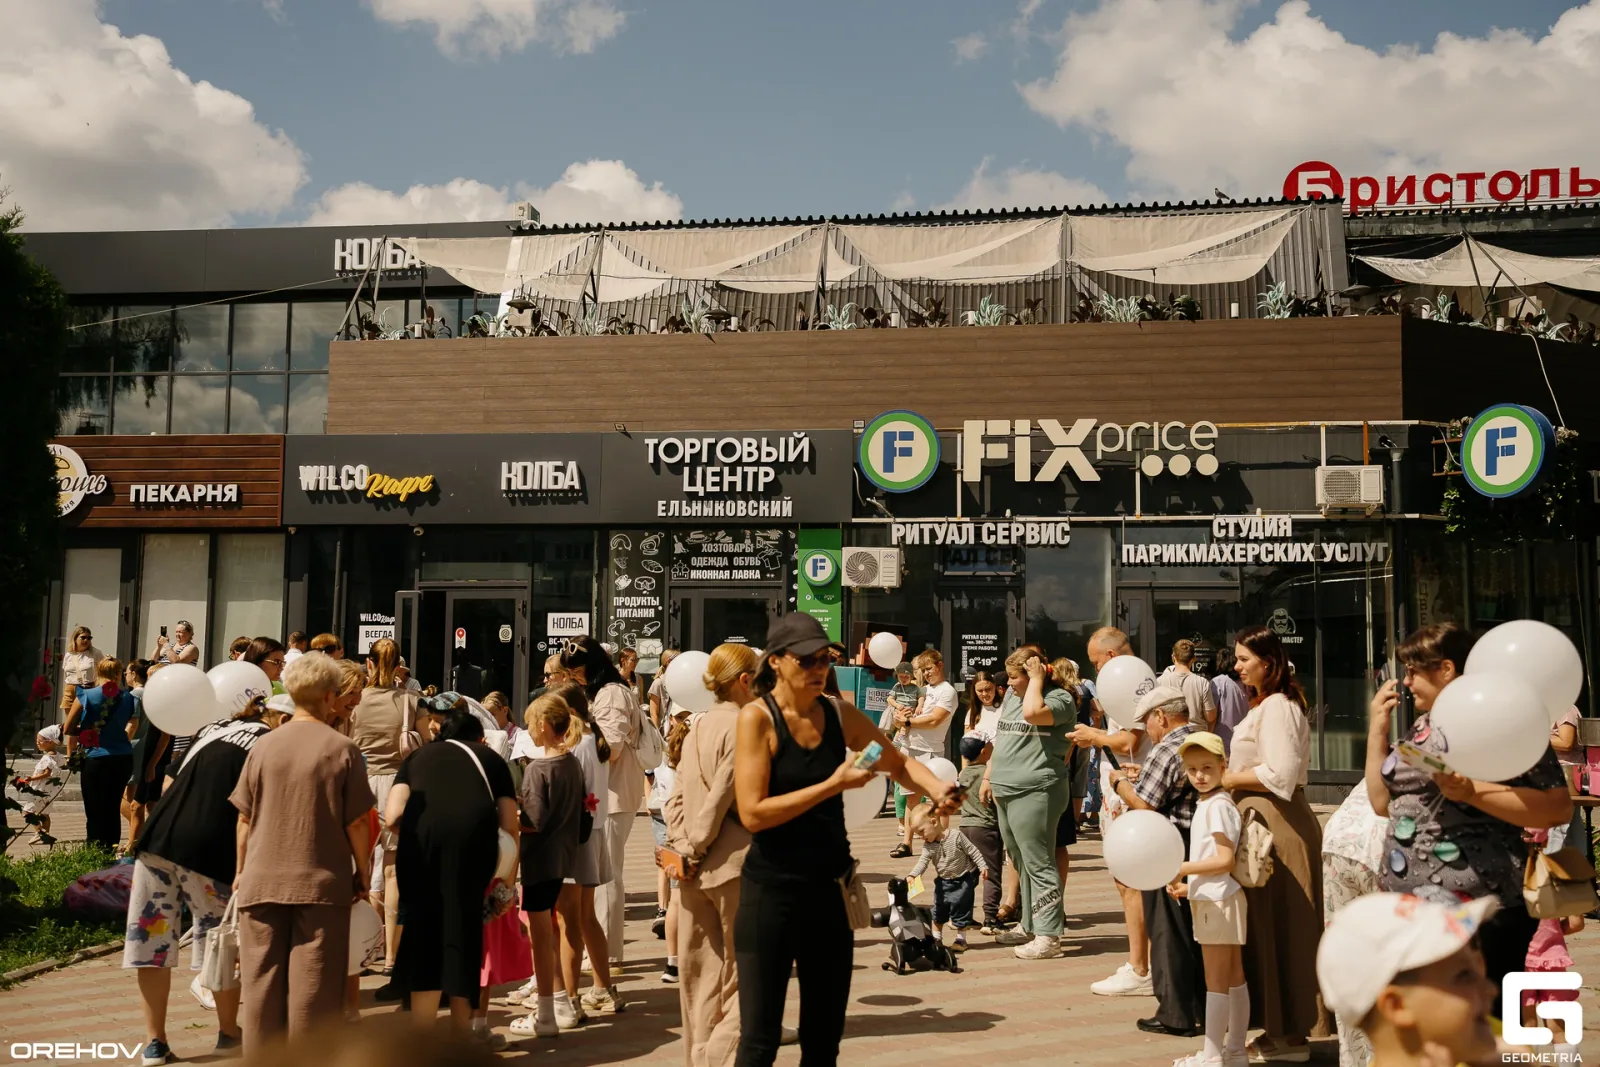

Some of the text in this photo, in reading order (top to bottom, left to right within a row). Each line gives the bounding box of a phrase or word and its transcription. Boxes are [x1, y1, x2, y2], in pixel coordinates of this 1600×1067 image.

[644, 432, 810, 464] ТОРГОВЫЙ
[1096, 420, 1219, 460] price
[299, 464, 369, 492] WILCO
[501, 461, 581, 490] КОЛБА
[683, 466, 775, 497] ЦЕНТР
[129, 484, 238, 502] ПЕКАРНЯ
[657, 496, 793, 517] ЕЛЬНИКОВСКИЙ
[891, 522, 1071, 545] РИТУАЛ СЕРВИС
[1212, 517, 1293, 540] СТУДИЯ
[702, 543, 754, 553] ХОЗТОВАРЫ
[1121, 542, 1389, 564] ПАРИКМАХЕРСКИХ УСЛУГ
[691, 556, 761, 568] ОДЕЖДА ОБУВЬ
[690, 570, 761, 580] ИКОННАЯ ЛАВКА
[613, 596, 660, 607] ПРОДУКТЫ
[552, 617, 584, 629] КОЛБА
[616, 608, 655, 618] ПИТАНИЯ
